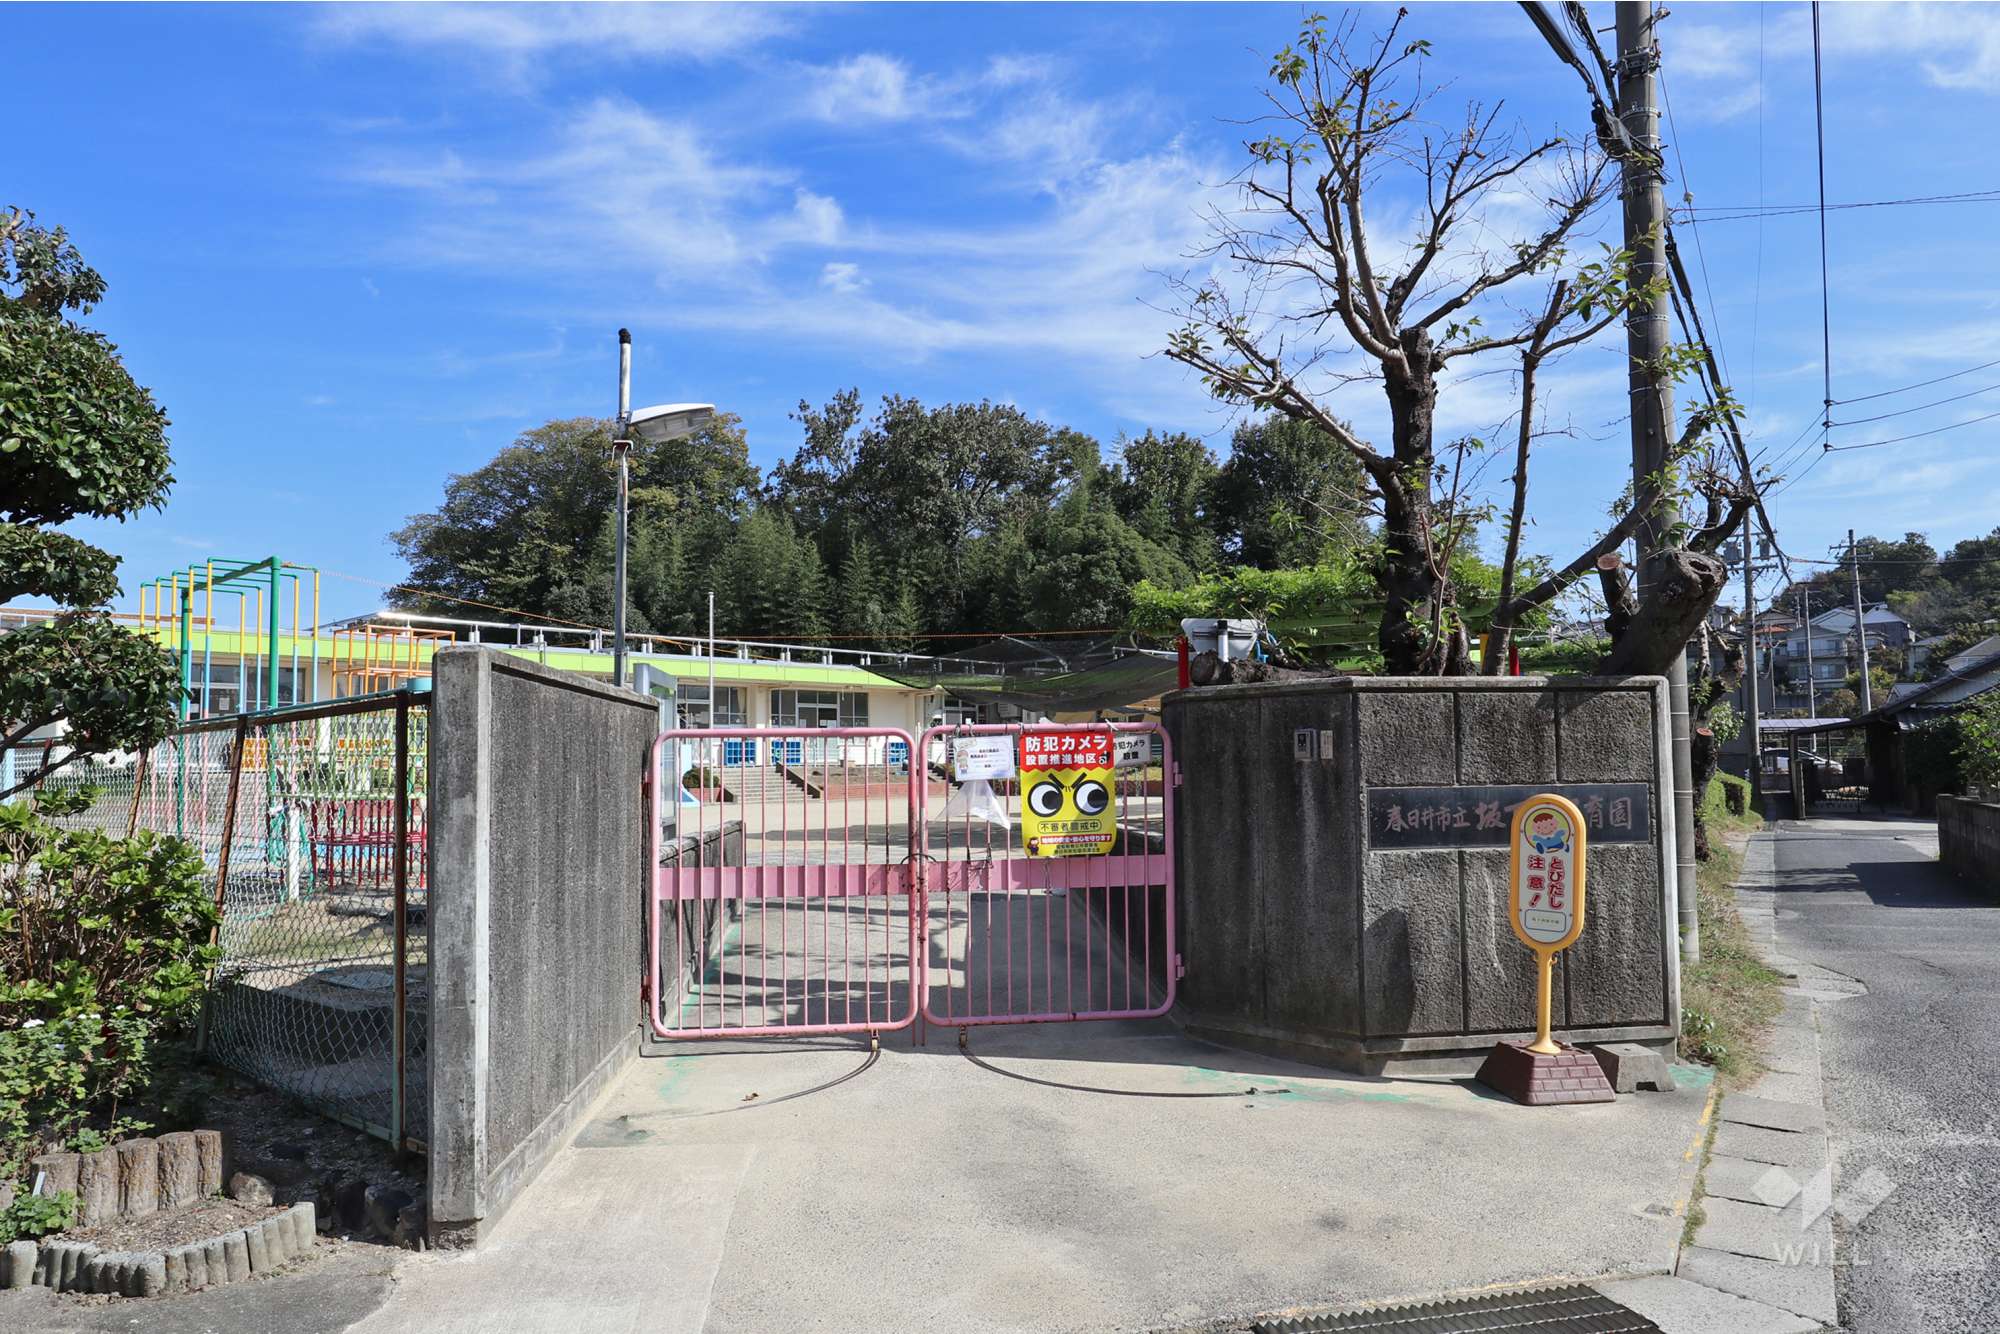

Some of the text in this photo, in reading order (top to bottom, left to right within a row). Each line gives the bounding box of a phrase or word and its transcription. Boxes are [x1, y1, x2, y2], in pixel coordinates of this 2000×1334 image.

[1025, 735, 1107, 753] 防犯カメラ
[1025, 753, 1096, 766] 設置推進地区
[1040, 821, 1099, 832] 不審者警戒中
[1548, 856, 1565, 909] とびだし
